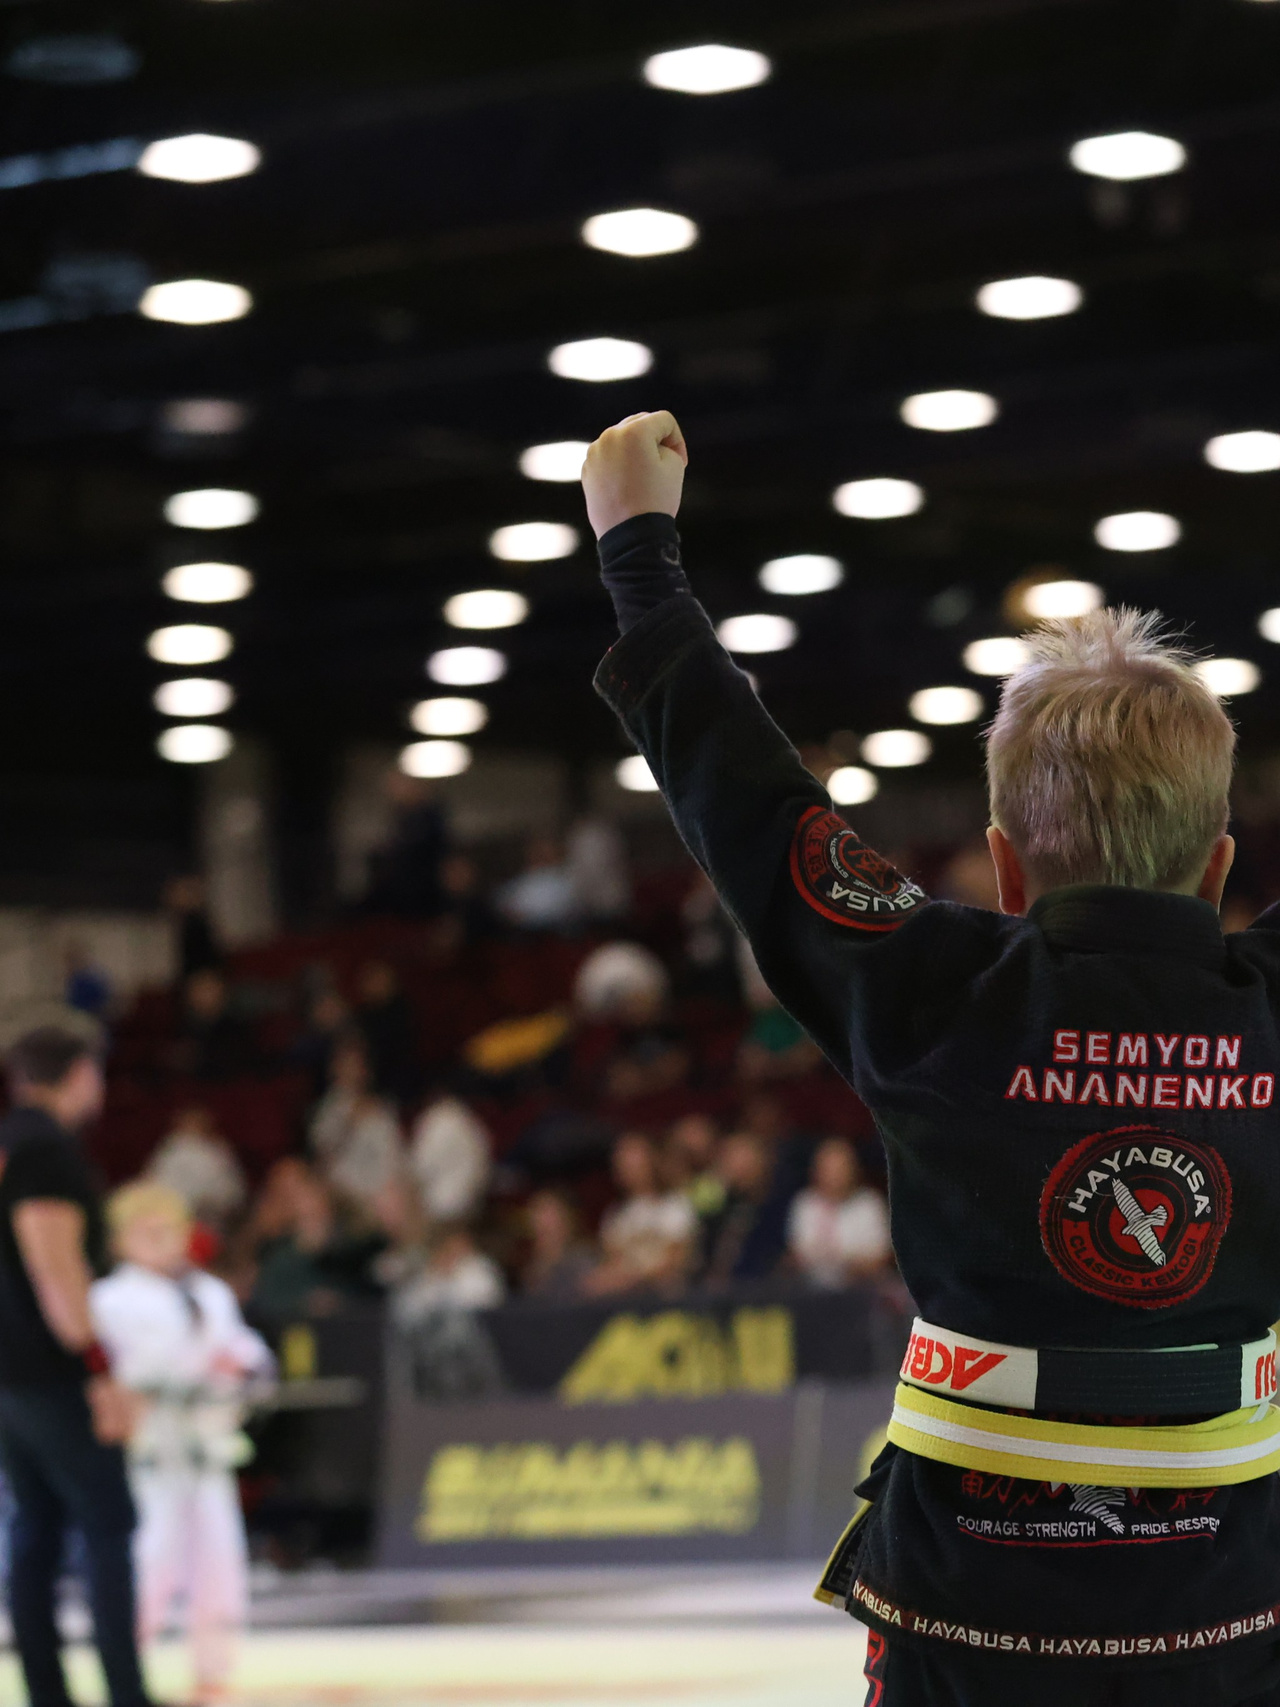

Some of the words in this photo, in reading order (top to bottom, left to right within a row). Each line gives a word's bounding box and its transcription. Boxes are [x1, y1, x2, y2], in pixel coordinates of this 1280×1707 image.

[831, 880, 925, 912] ABUSA
[1052, 1028, 1242, 1070] SEMYON
[1004, 1064, 1275, 1110] ANANENKO
[1067, 1146, 1210, 1218] HAYABUSA
[1069, 1235, 1135, 1286] CLASSIC
[1141, 1237, 1198, 1288] KEIKOGI
[956, 1514, 1020, 1536] COURAGE
[1025, 1520, 1096, 1538] STRENGTH
[1131, 1518, 1171, 1535] PRIDE
[913, 1616, 1032, 1653] HAYABUSA
[1040, 1637, 1168, 1656] HAYABUSA
[1175, 1610, 1275, 1650] HAYABUSA
